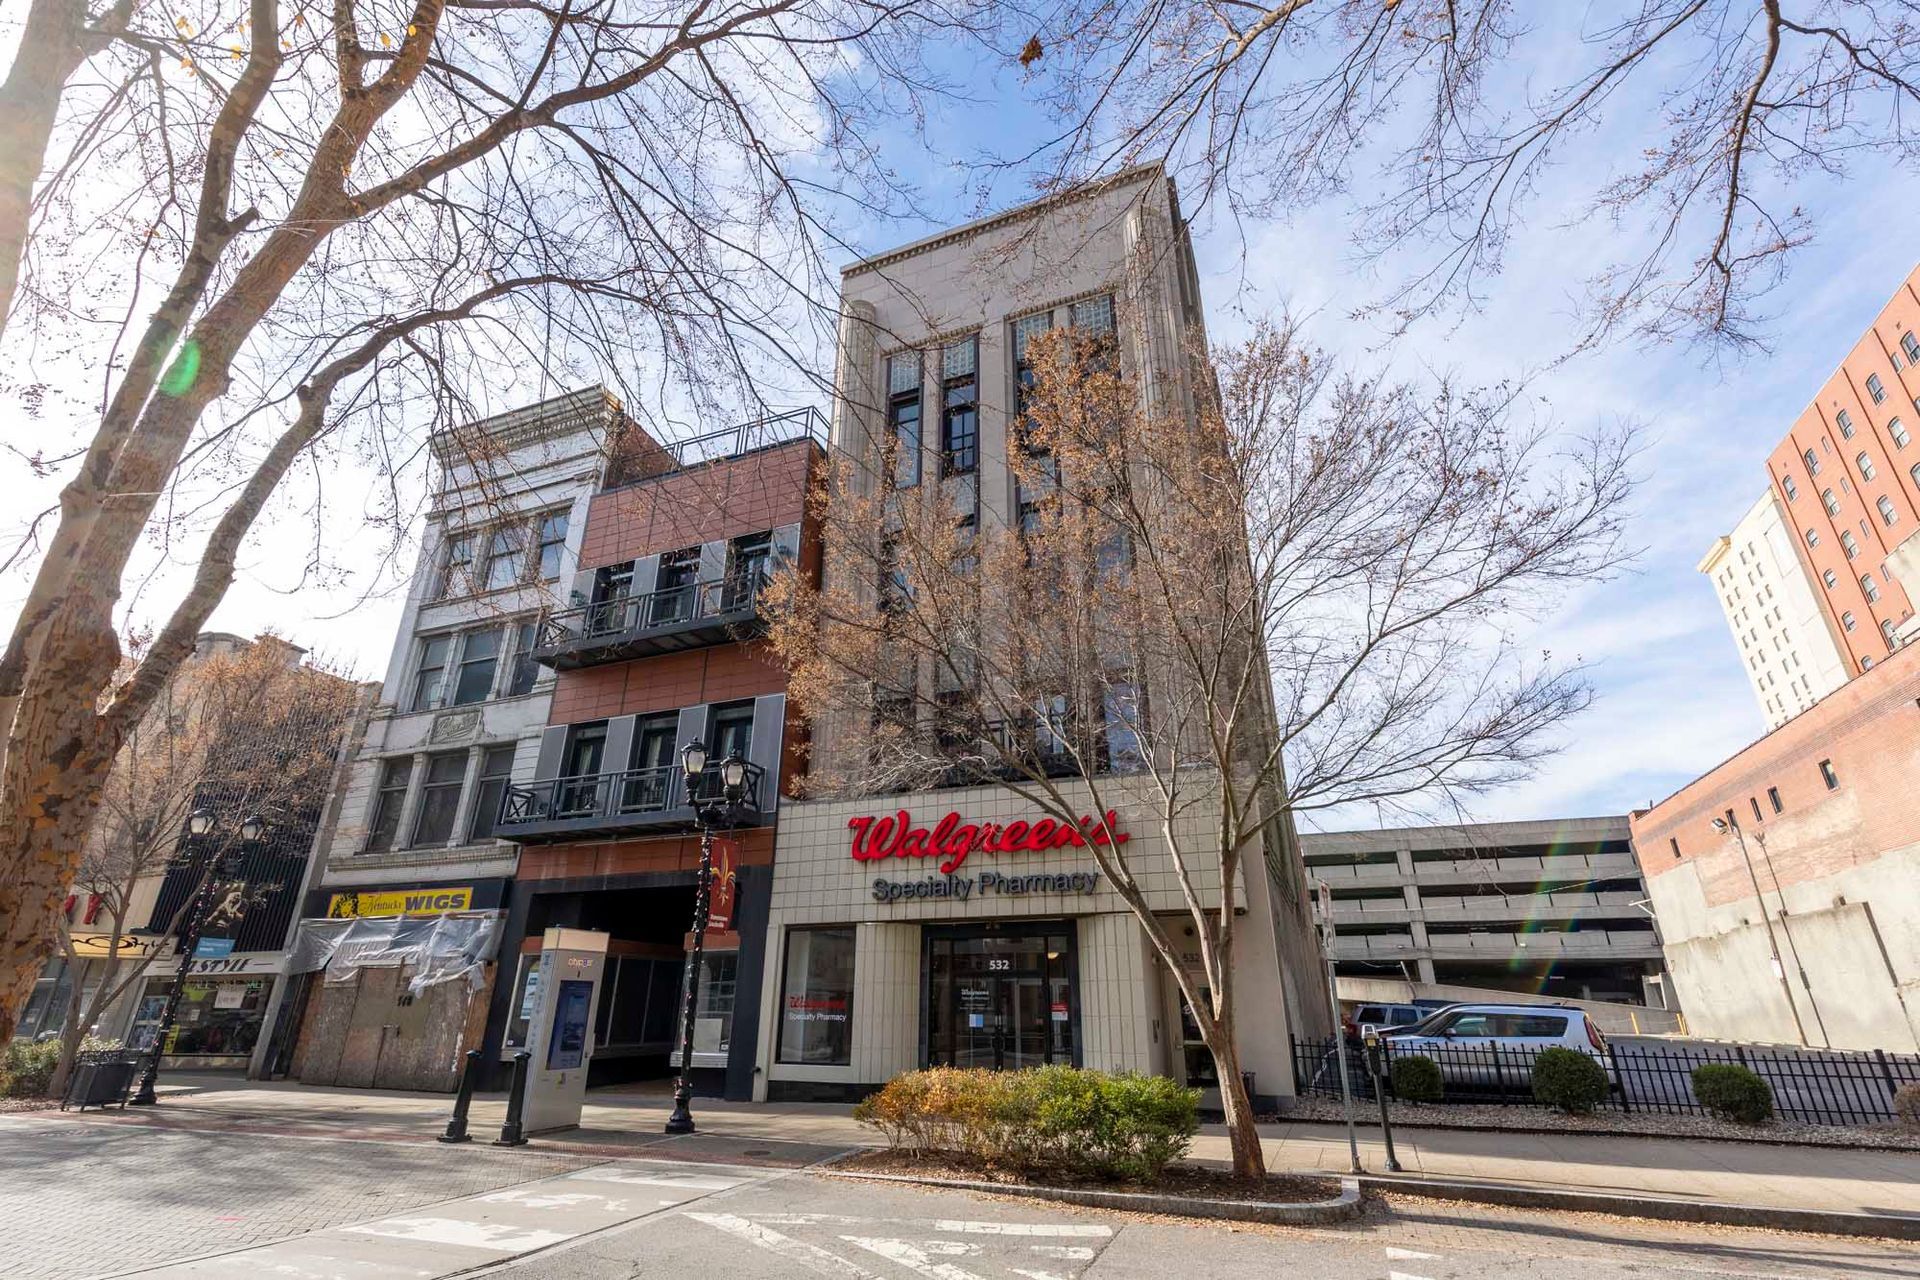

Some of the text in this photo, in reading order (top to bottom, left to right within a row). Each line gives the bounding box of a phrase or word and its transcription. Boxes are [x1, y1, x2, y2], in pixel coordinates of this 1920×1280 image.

[848, 809, 1131, 874] Walgreens
[872, 871, 1098, 900] Specialty Pharmacy
[405, 893, 465, 911] WIGS
[989, 959, 1010, 970] 532
[816, 1012, 847, 1022] Pharmacy
